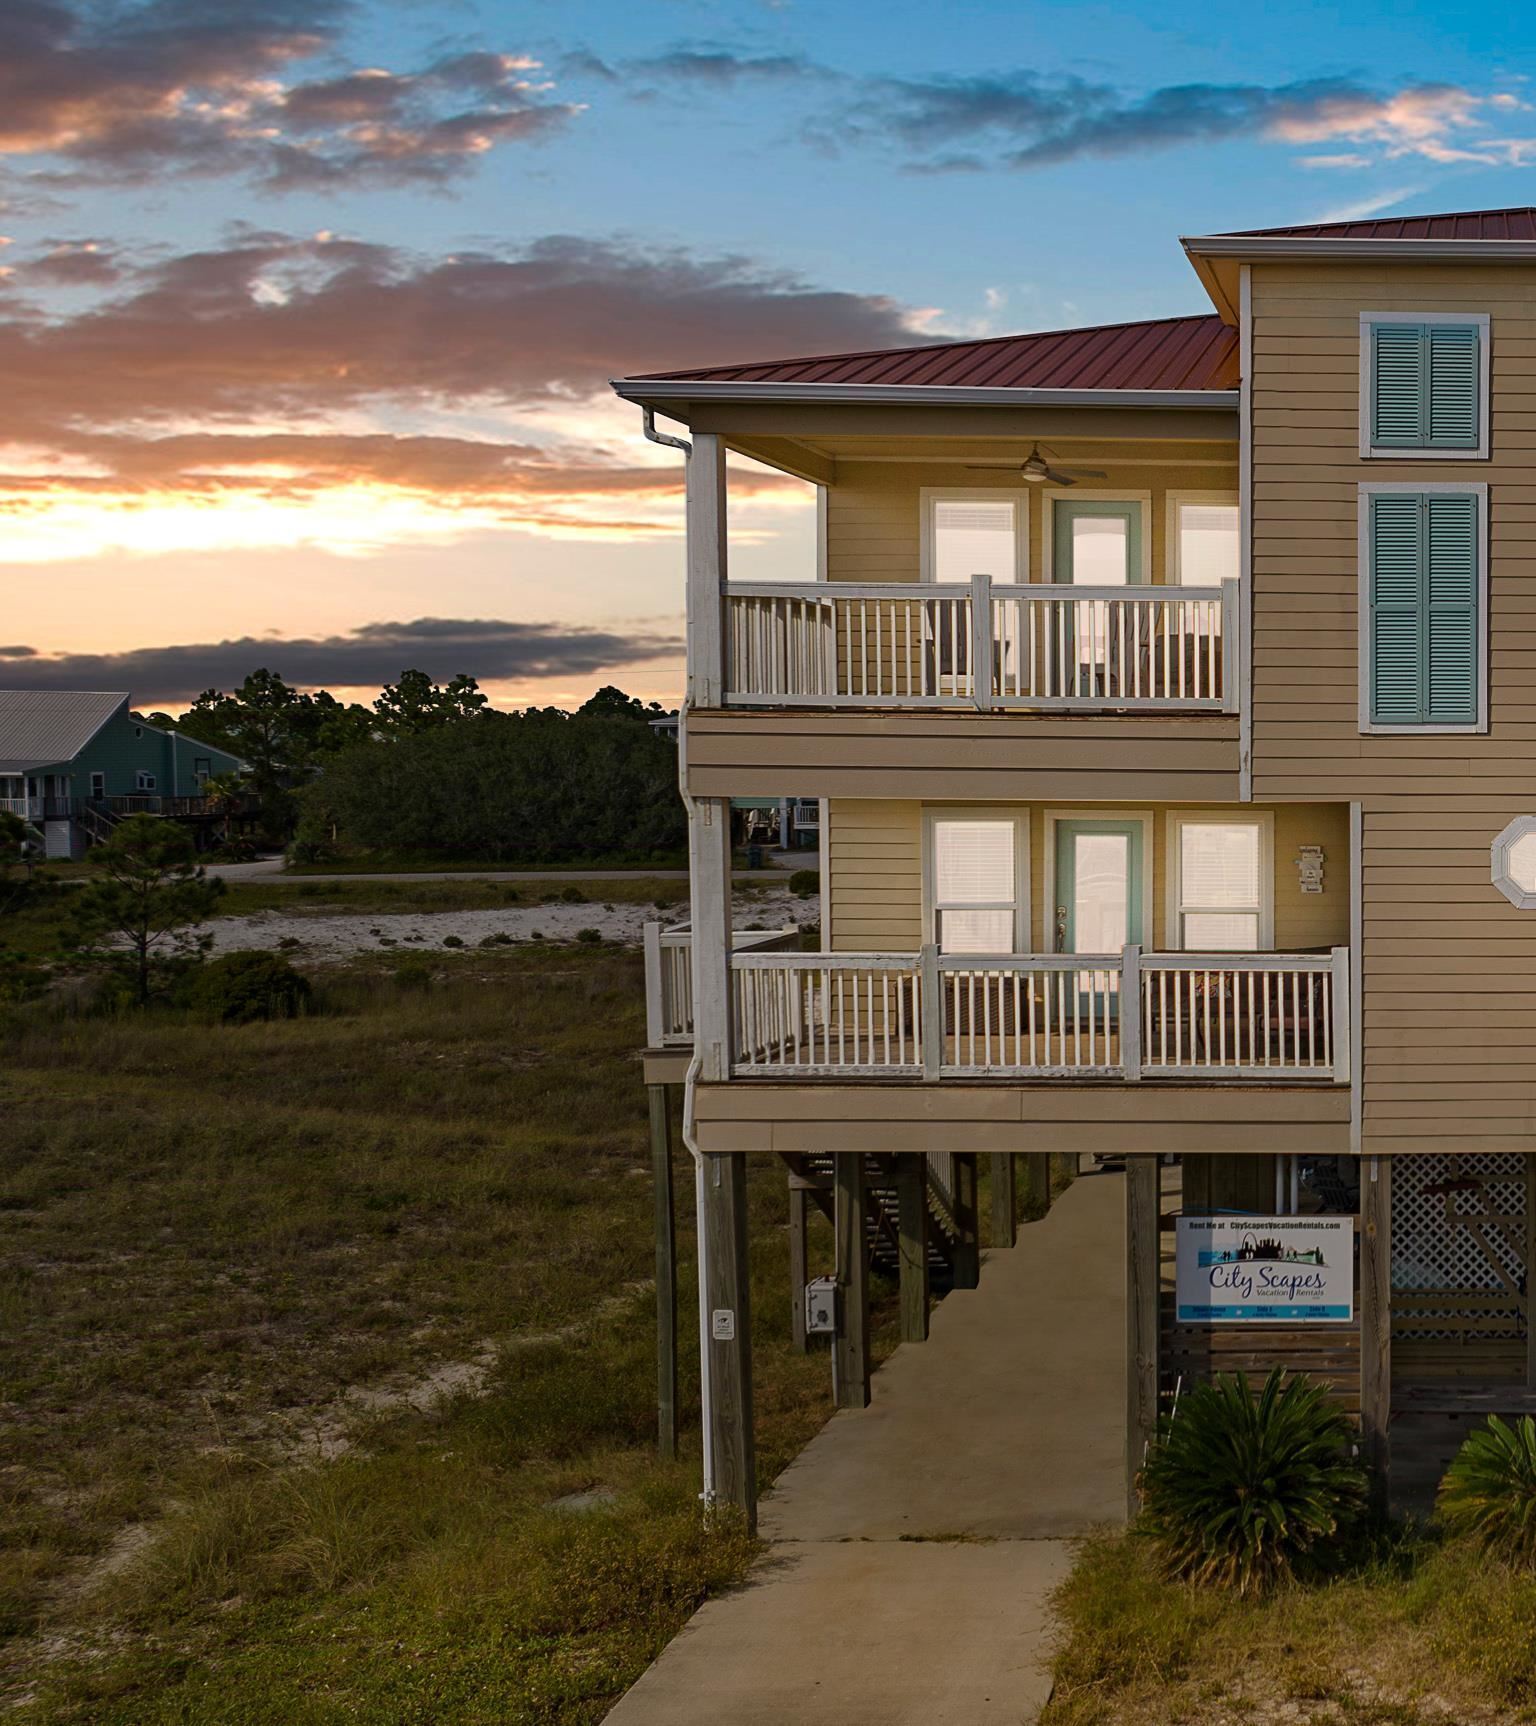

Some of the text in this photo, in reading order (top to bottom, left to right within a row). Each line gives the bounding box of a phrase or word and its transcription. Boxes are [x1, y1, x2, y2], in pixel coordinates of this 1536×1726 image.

[1189, 1221, 1205, 1230] Rent
[1206, 1221, 1217, 1230] Me
[1209, 1264, 1327, 1301] City Scapes
[1257, 1289, 1325, 1297] Vacation Rentals
